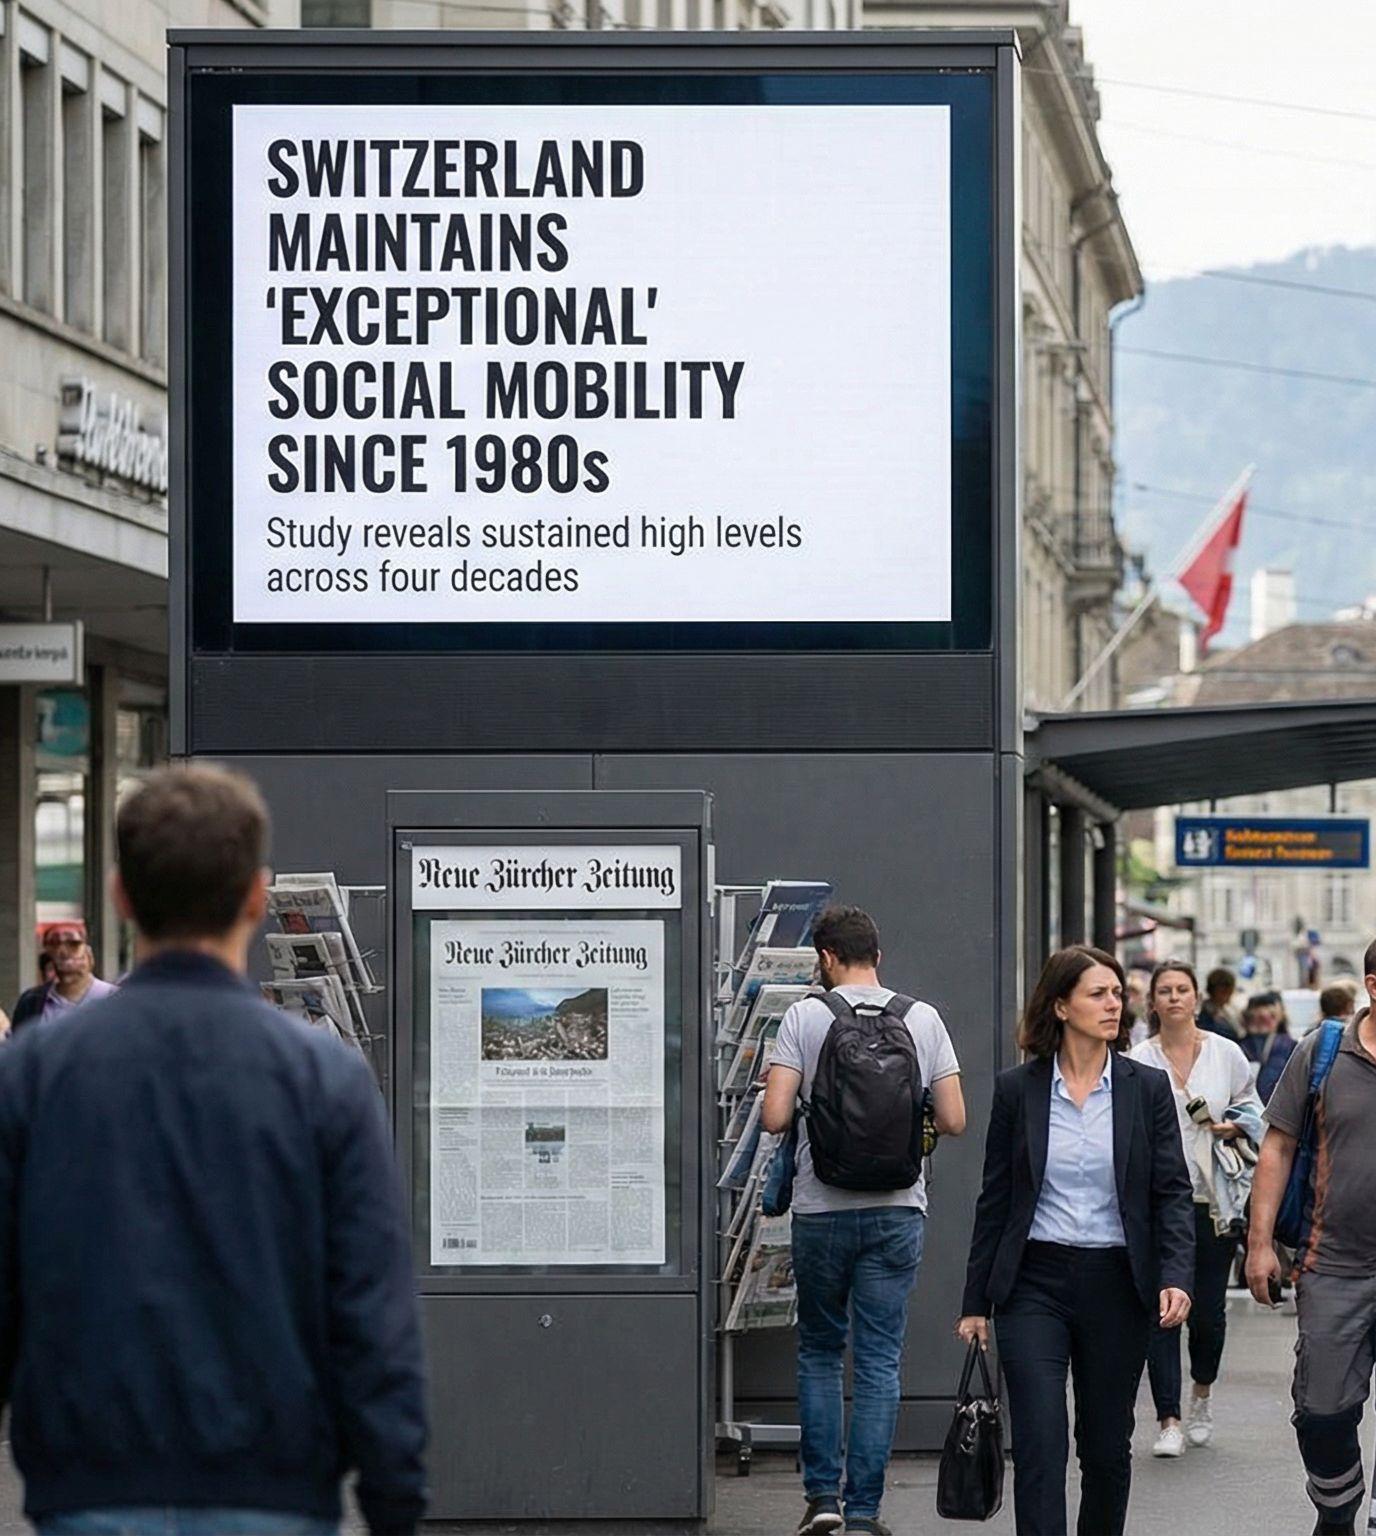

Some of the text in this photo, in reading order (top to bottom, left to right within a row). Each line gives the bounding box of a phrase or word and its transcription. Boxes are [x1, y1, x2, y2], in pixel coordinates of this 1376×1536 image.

[267, 139, 644, 199] SWITZERLAND
[269, 212, 569, 273] MAINTAINS
[266, 286, 658, 346] ‘EXCEPTIONAL’
[268, 360, 745, 420] SOCIAL MOBILITY
[267, 434, 610, 494] SINCE 1980s
[266, 515, 802, 557] Study reveals sustained high levels
[267, 559, 579, 593] across four decades
[418, 857, 675, 896] Neue Zürcher Zeitung
[445, 940, 648, 970] Neue Zürcher Zeitung
